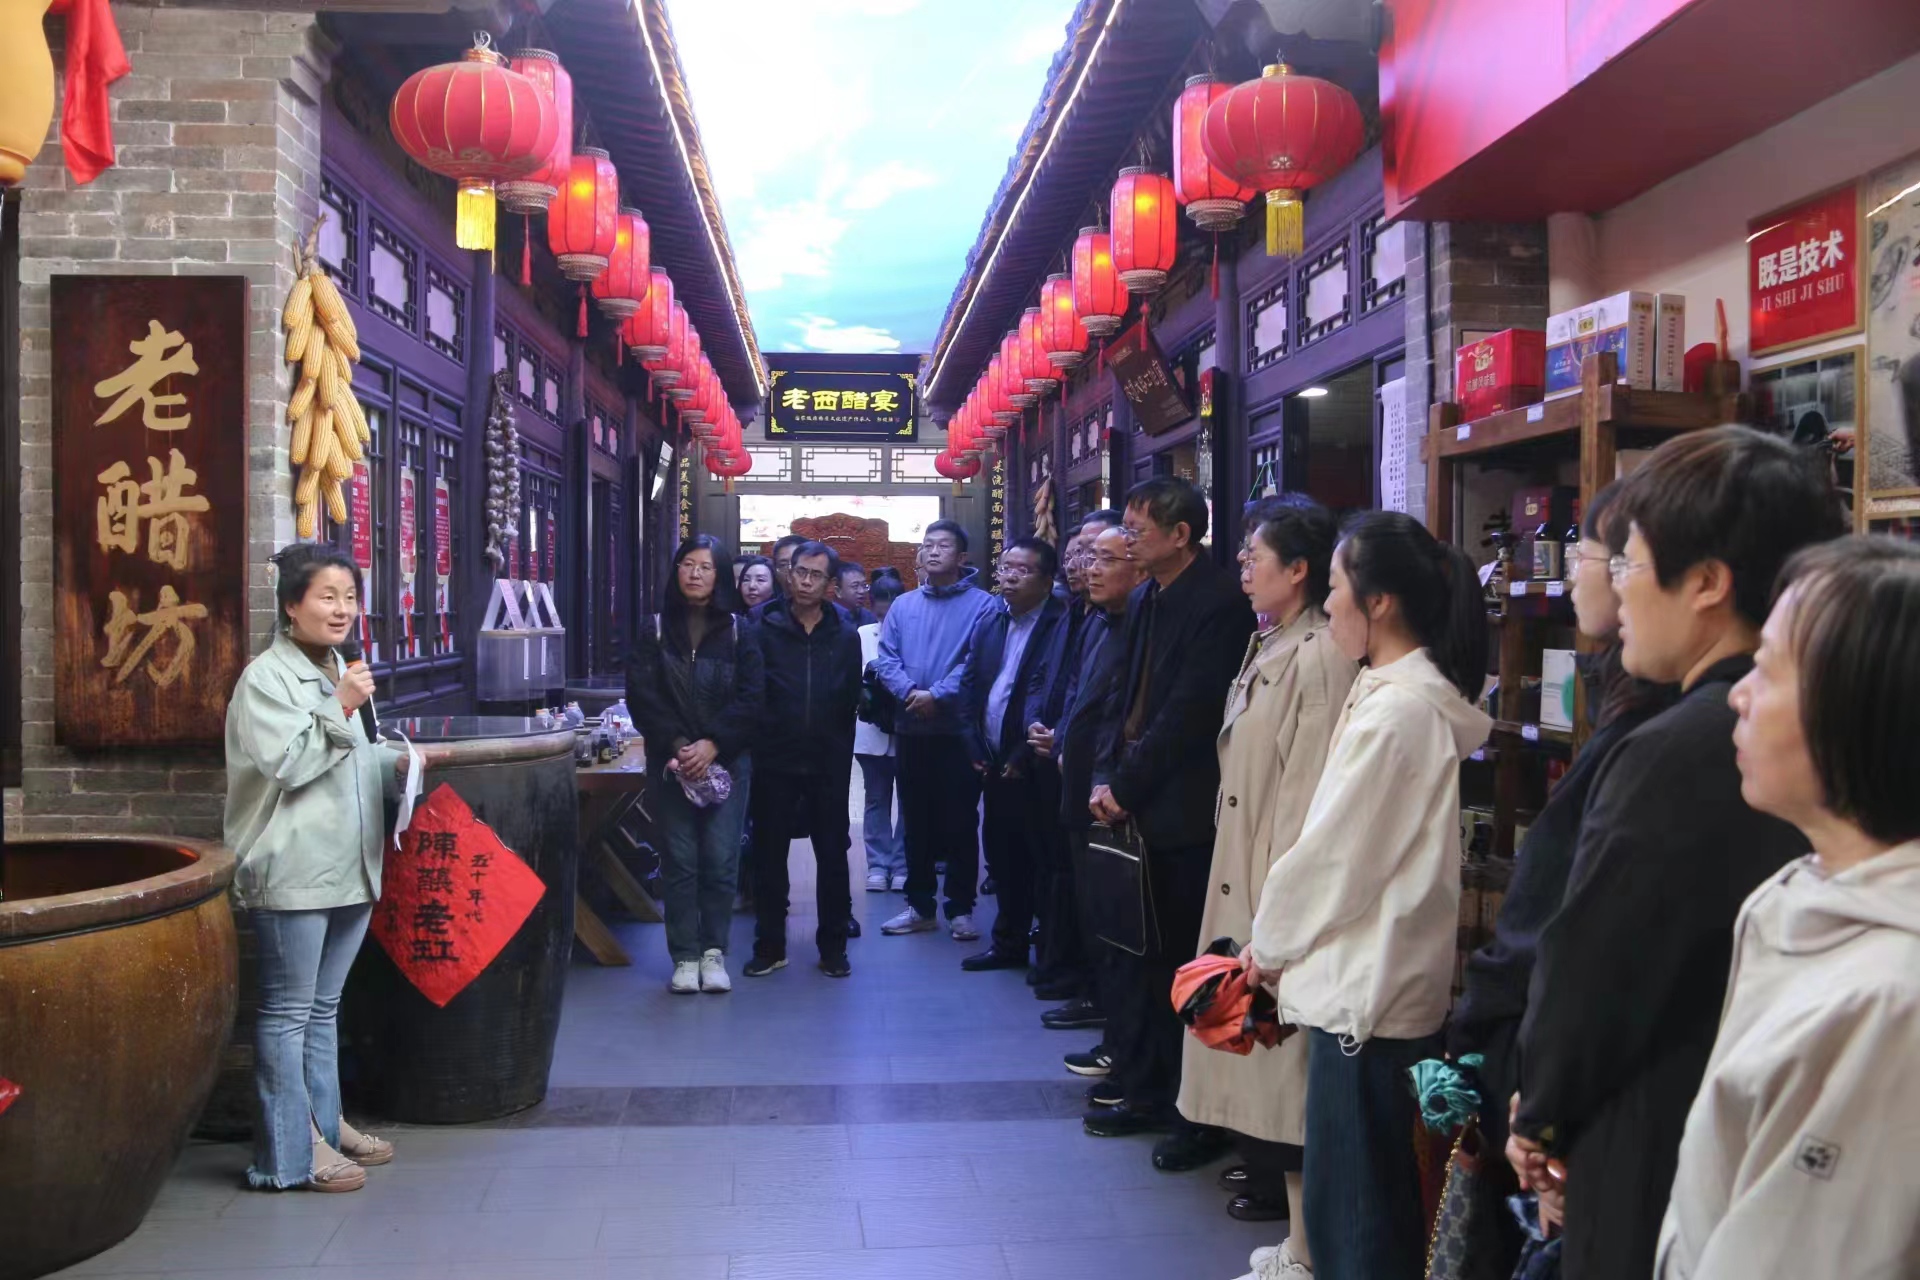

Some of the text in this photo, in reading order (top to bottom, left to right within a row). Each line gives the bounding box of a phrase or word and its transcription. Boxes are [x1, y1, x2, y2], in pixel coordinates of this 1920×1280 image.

[1758, 229, 1844, 290] 既是技术
[1760, 273, 1845, 312] JI SHI JI SHU
[782, 388, 899, 412] 老西醋宴
[94, 319, 209, 688] 老醋坊
